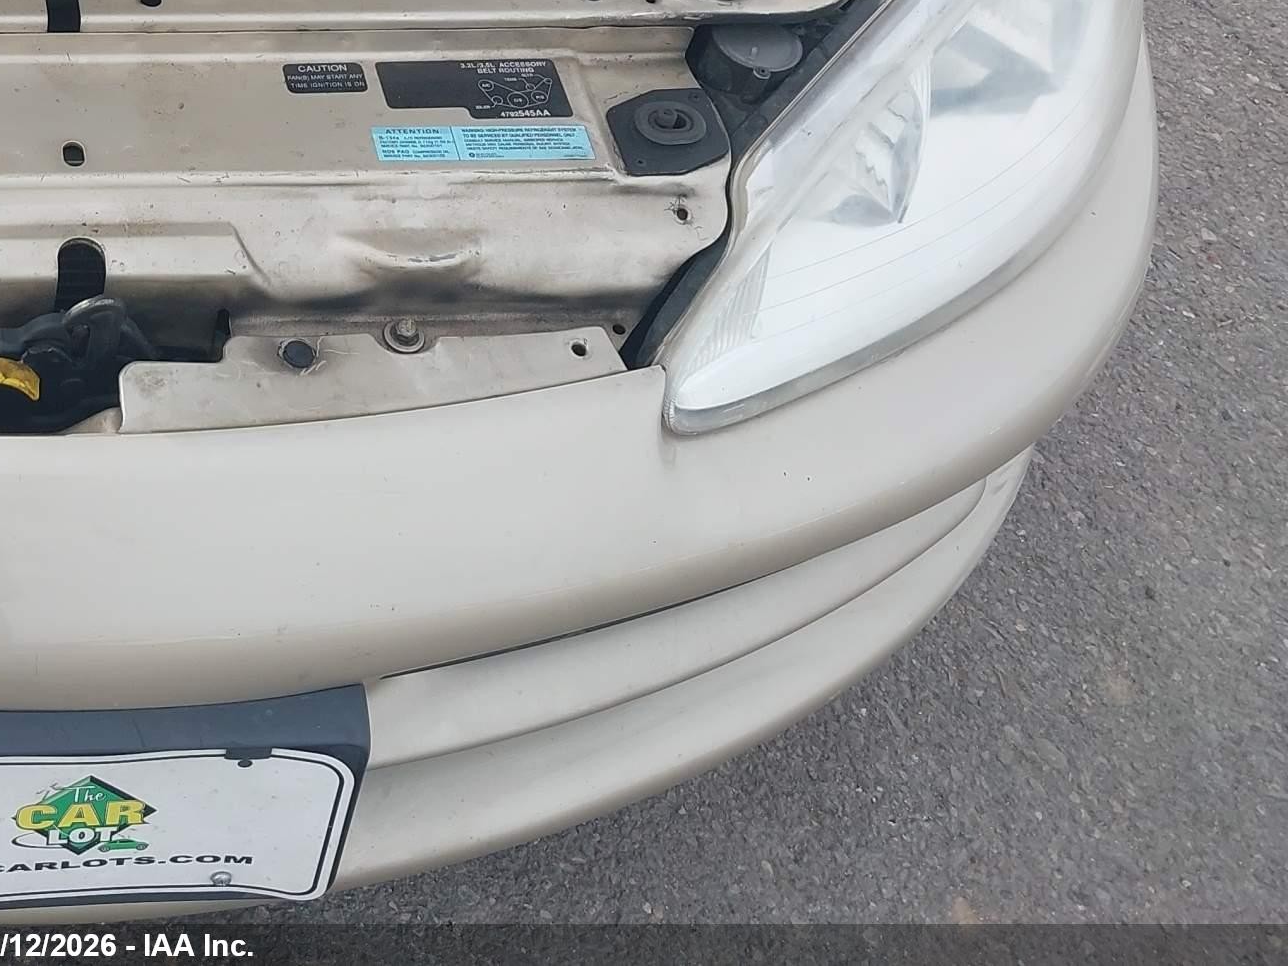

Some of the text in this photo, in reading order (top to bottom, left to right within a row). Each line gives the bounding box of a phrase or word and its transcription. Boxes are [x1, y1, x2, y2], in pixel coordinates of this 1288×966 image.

[297, 64, 347, 72] CAUTION
[64, 785, 107, 803] The
[16, 799, 150, 831] CAR
[47, 826, 120, 846] LOT
